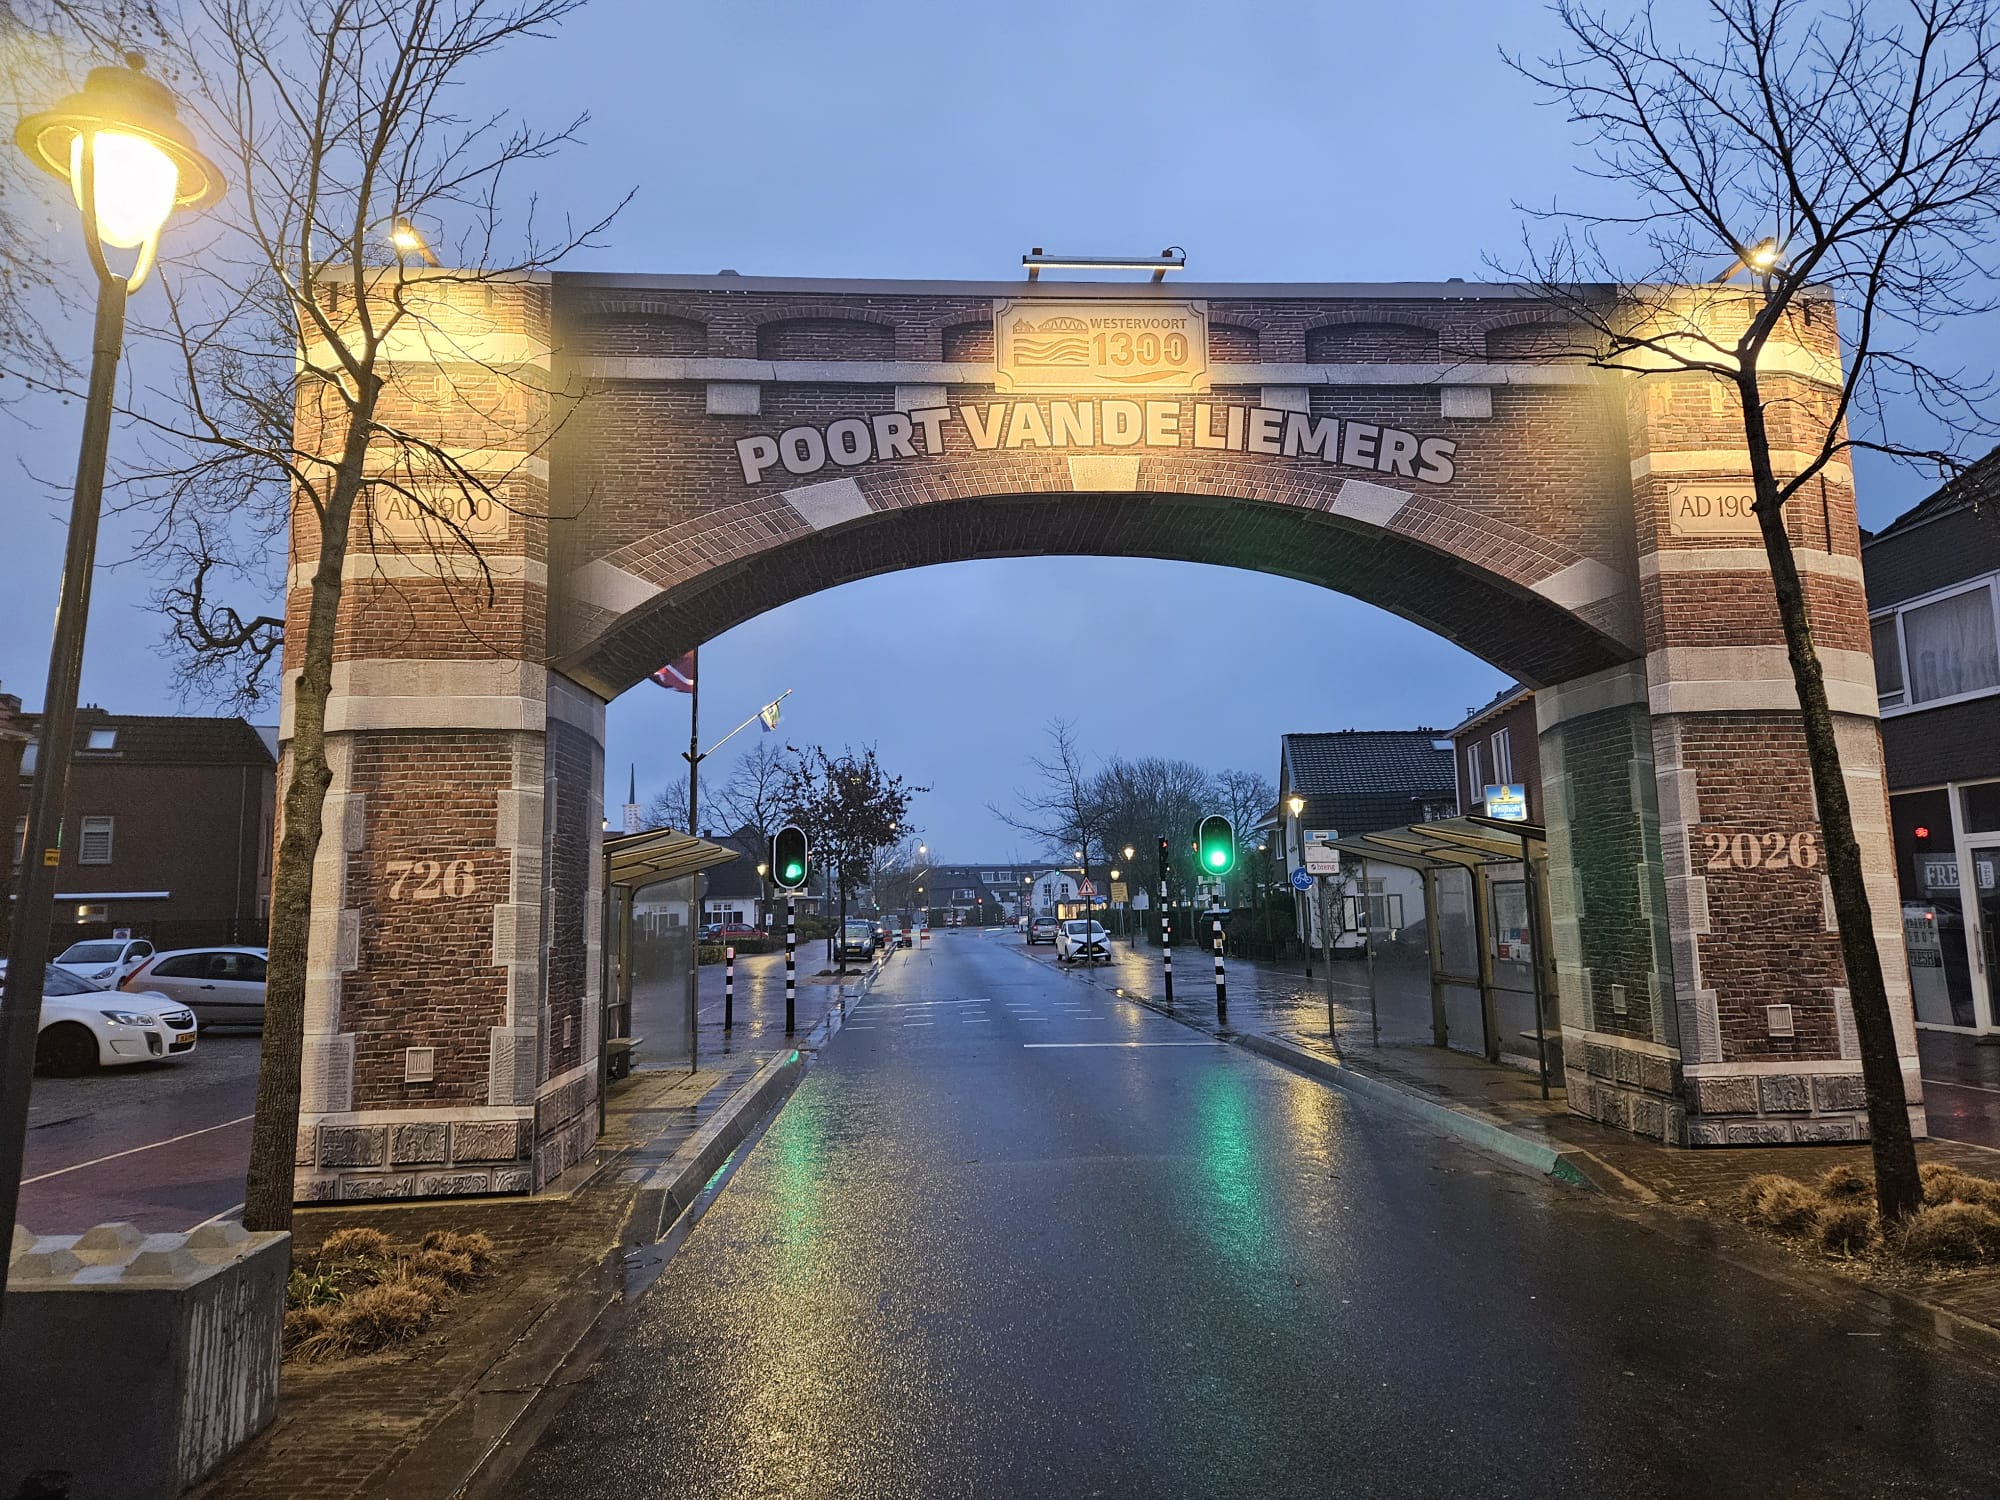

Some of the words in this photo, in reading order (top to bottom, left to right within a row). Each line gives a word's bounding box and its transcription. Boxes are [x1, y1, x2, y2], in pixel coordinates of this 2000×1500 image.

[1089, 318, 1188, 329] WESTERVOORT
[1093, 332, 1189, 366] 1300
[735, 406, 951, 485] POORT
[1193, 402, 1458, 485] LIEMERS
[1679, 495, 1712, 518] AD
[1716, 495, 1755, 518] 190
[1704, 831, 1819, 870] 2026
[385, 859, 476, 900] 726
